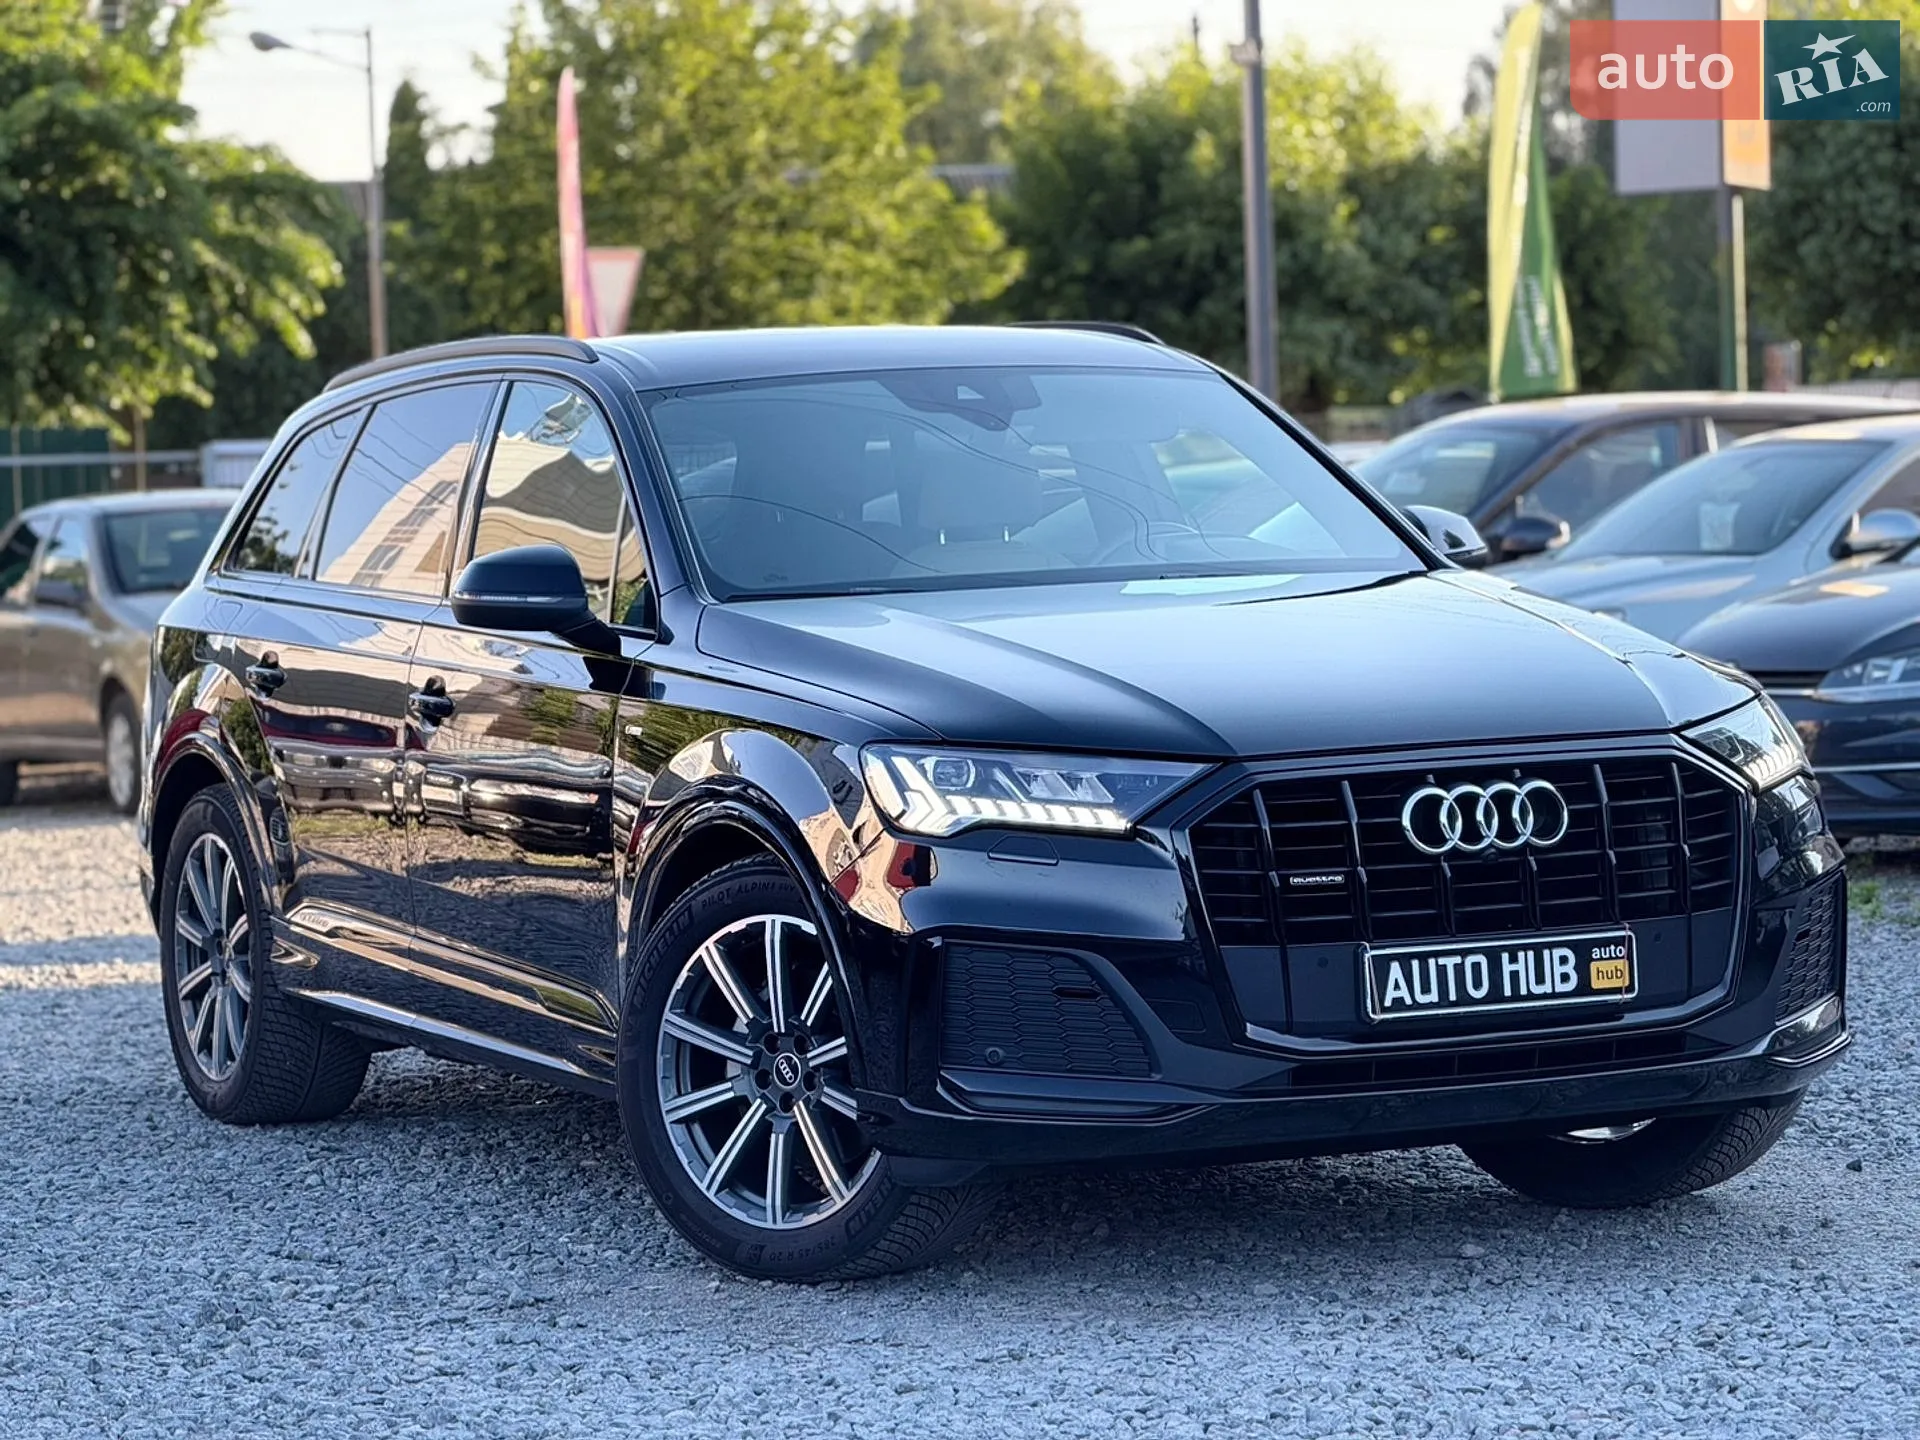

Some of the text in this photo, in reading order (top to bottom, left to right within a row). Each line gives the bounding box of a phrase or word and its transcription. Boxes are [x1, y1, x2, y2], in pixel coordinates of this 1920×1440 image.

[1292, 875, 1343, 884] quattro
[701, 887, 731, 909] PILOT
[632, 904, 694, 1010] MICHELIN
[1592, 944, 1625, 959] auto
[1384, 947, 1579, 1008] AUTO HUB
[1595, 966, 1624, 981] hub
[846, 1176, 893, 1240] HELIN
